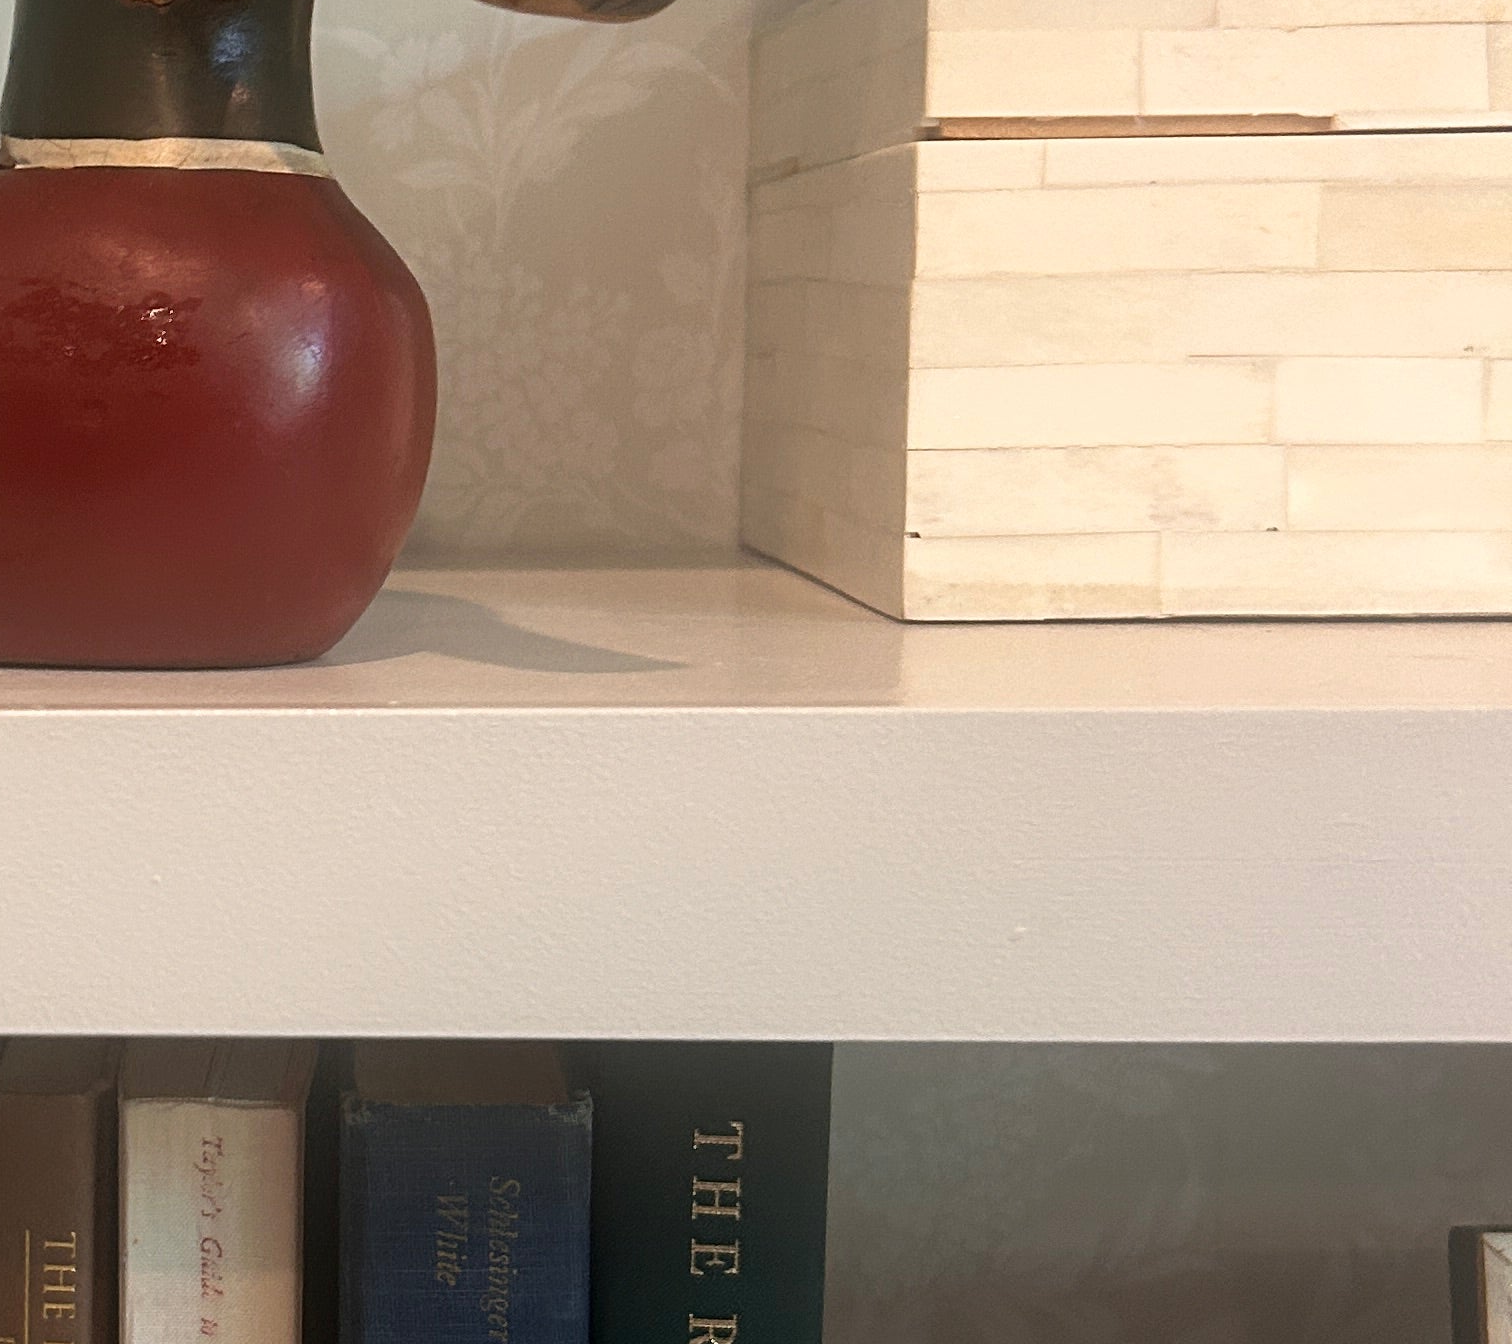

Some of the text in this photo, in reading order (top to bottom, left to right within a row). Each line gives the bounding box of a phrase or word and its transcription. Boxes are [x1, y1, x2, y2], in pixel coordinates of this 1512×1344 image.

[435, 1194, 469, 1287] White
[480, 1175, 521, 1344] Schlesinger
[690, 1121, 744, 1276] THE
[41, 1231, 77, 1320] THE
